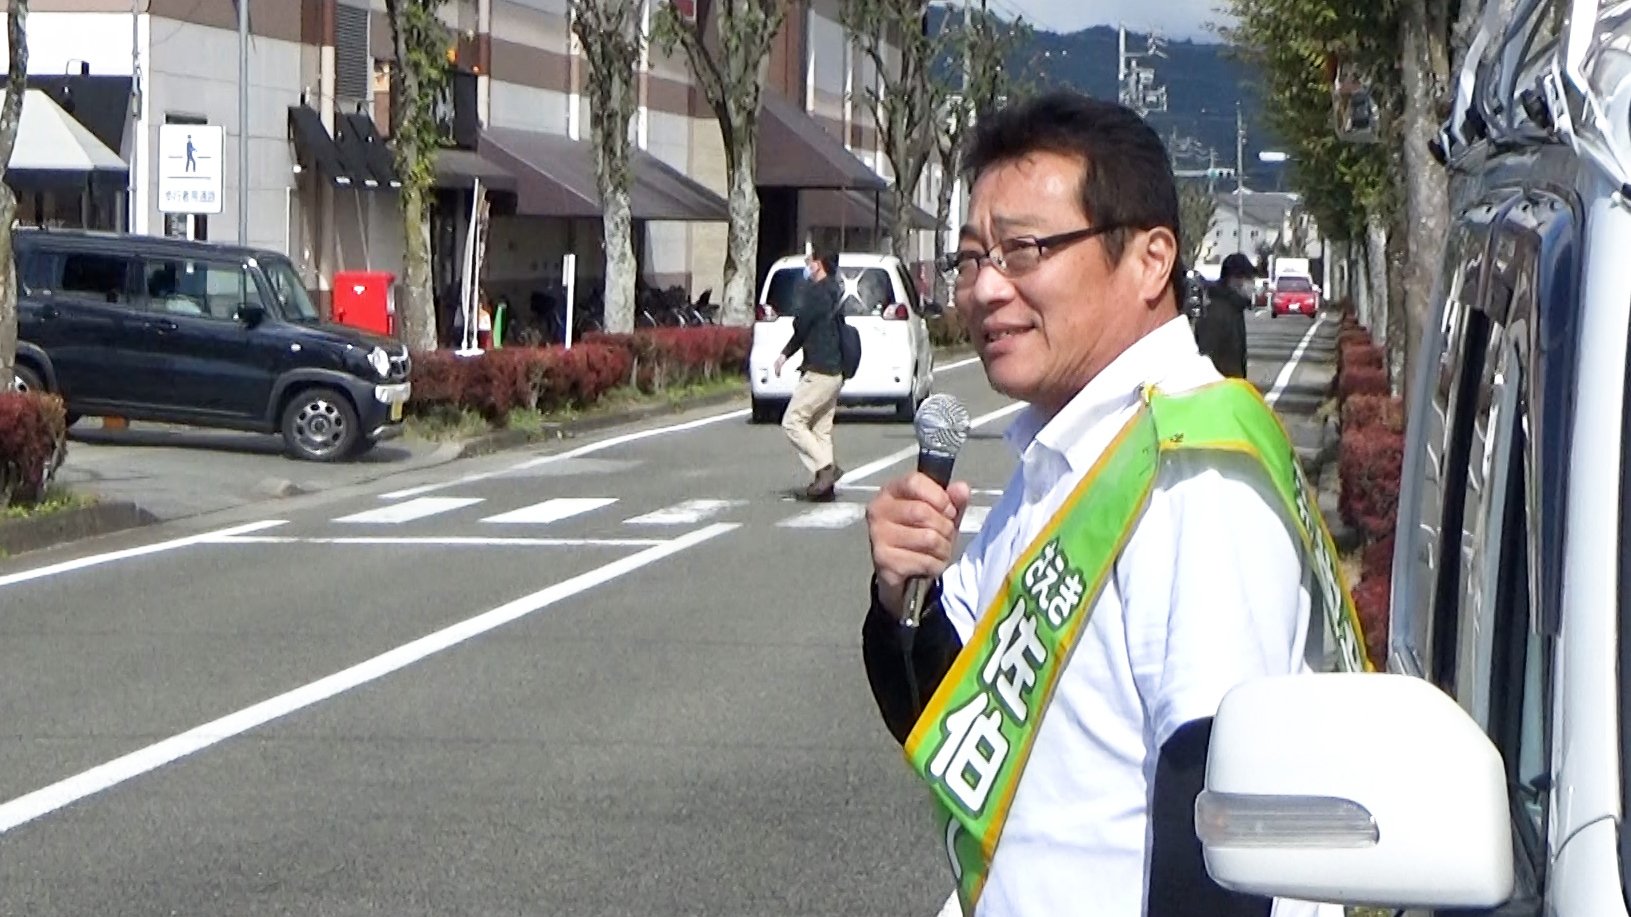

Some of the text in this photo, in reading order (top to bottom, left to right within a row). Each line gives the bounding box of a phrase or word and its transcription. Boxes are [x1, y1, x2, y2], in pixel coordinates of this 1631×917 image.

[1024, 540, 1084, 628] さえき
[928, 597, 1047, 813] 佐伯
